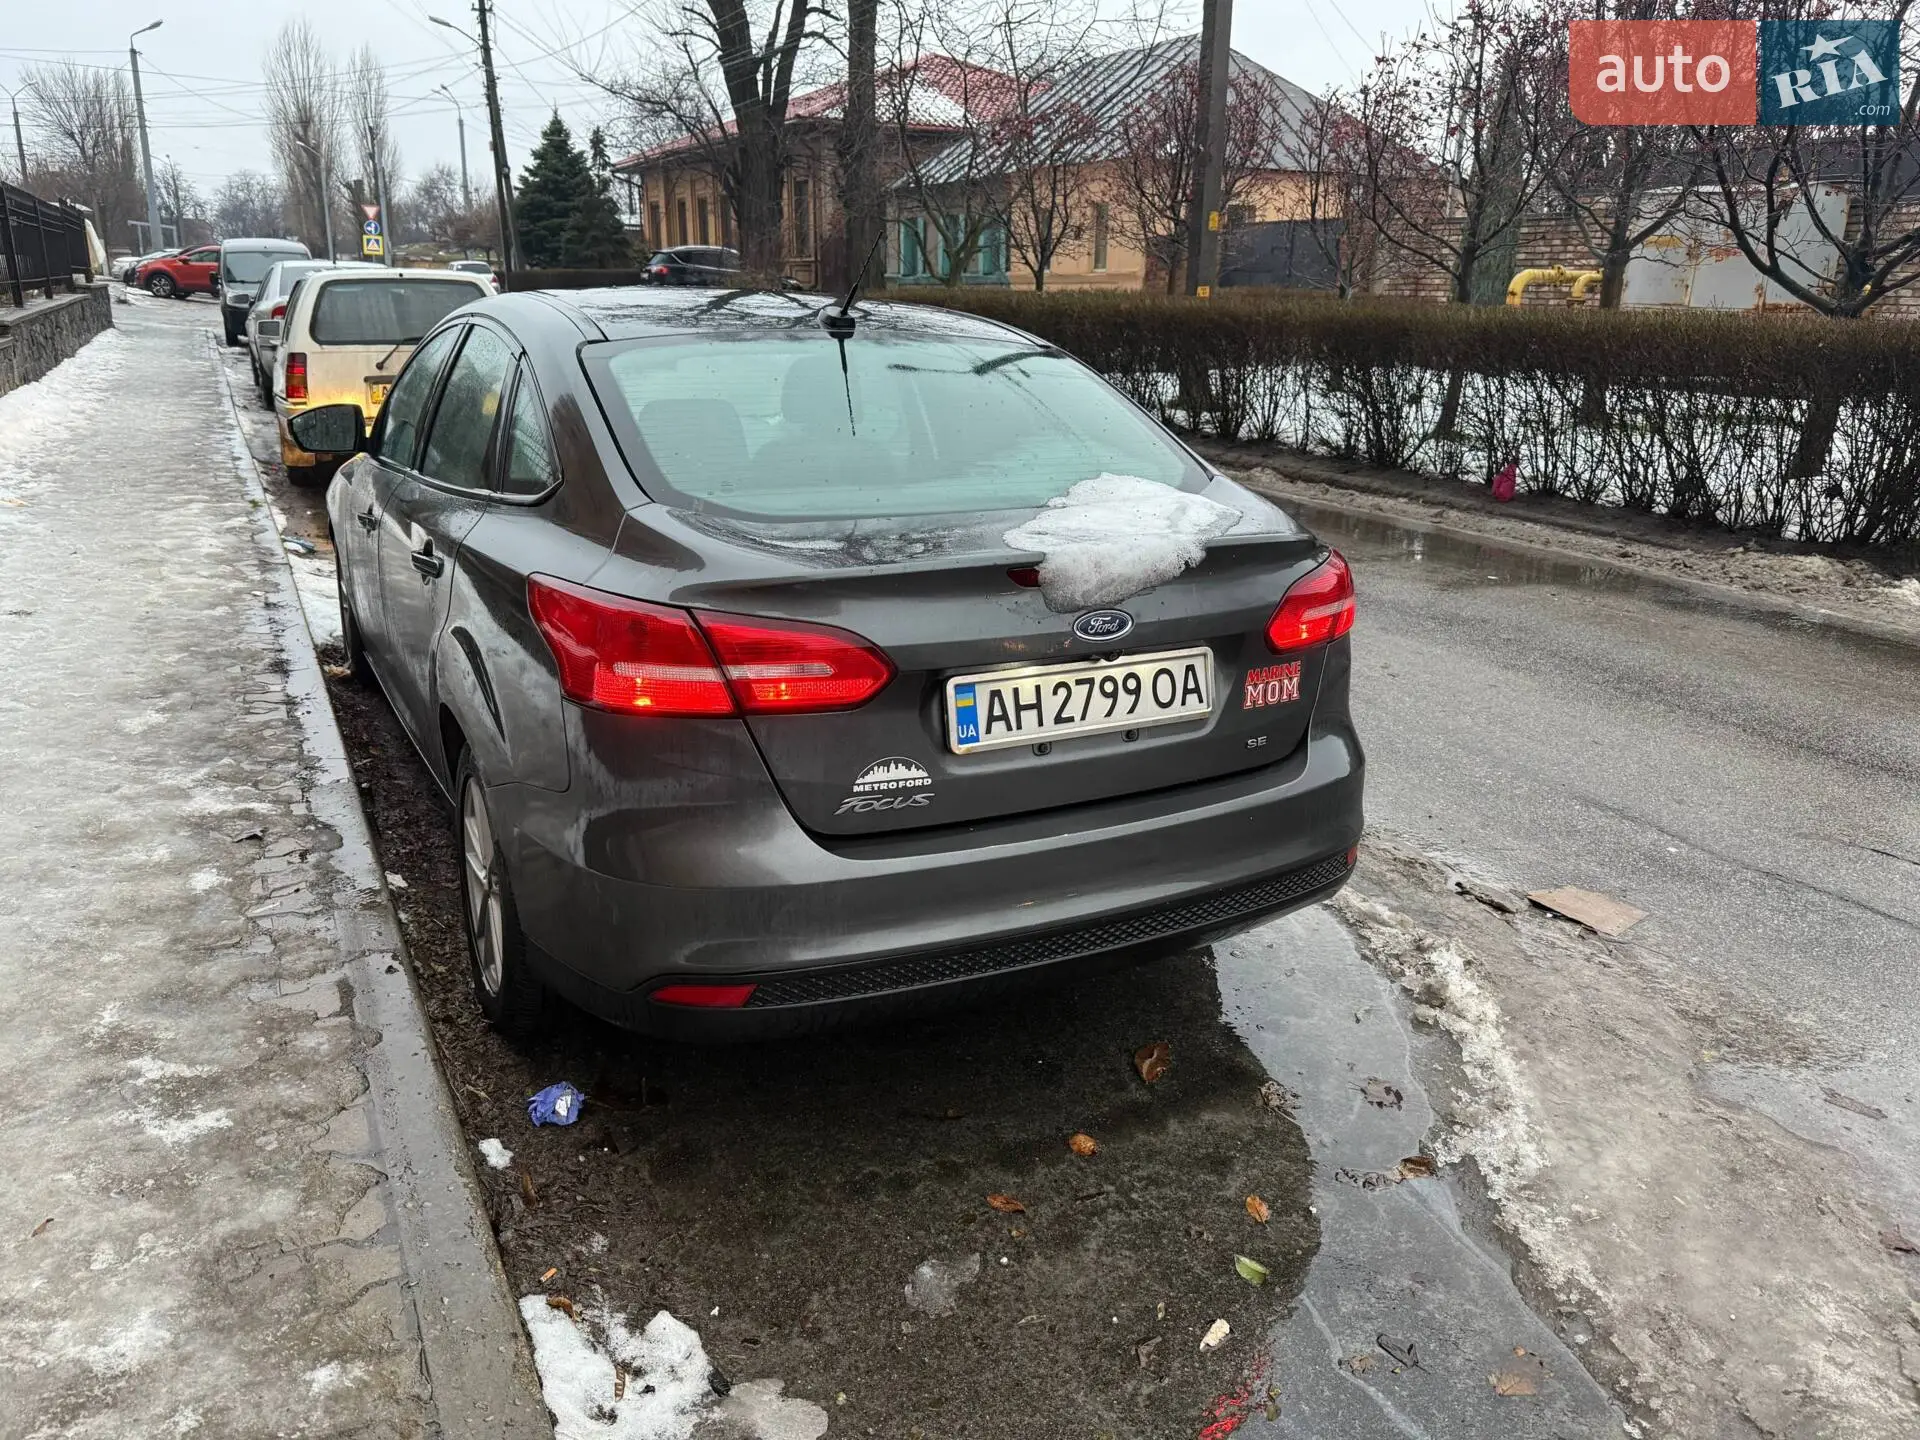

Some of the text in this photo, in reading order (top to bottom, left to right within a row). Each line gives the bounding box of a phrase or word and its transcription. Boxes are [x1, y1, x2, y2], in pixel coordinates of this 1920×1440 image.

[1088, 616, 1119, 633] Ford
[1246, 660, 1301, 685] MARINE
[1244, 677, 1300, 710] MOM
[958, 724, 977, 738] UA
[1246, 736, 1267, 749] SE
